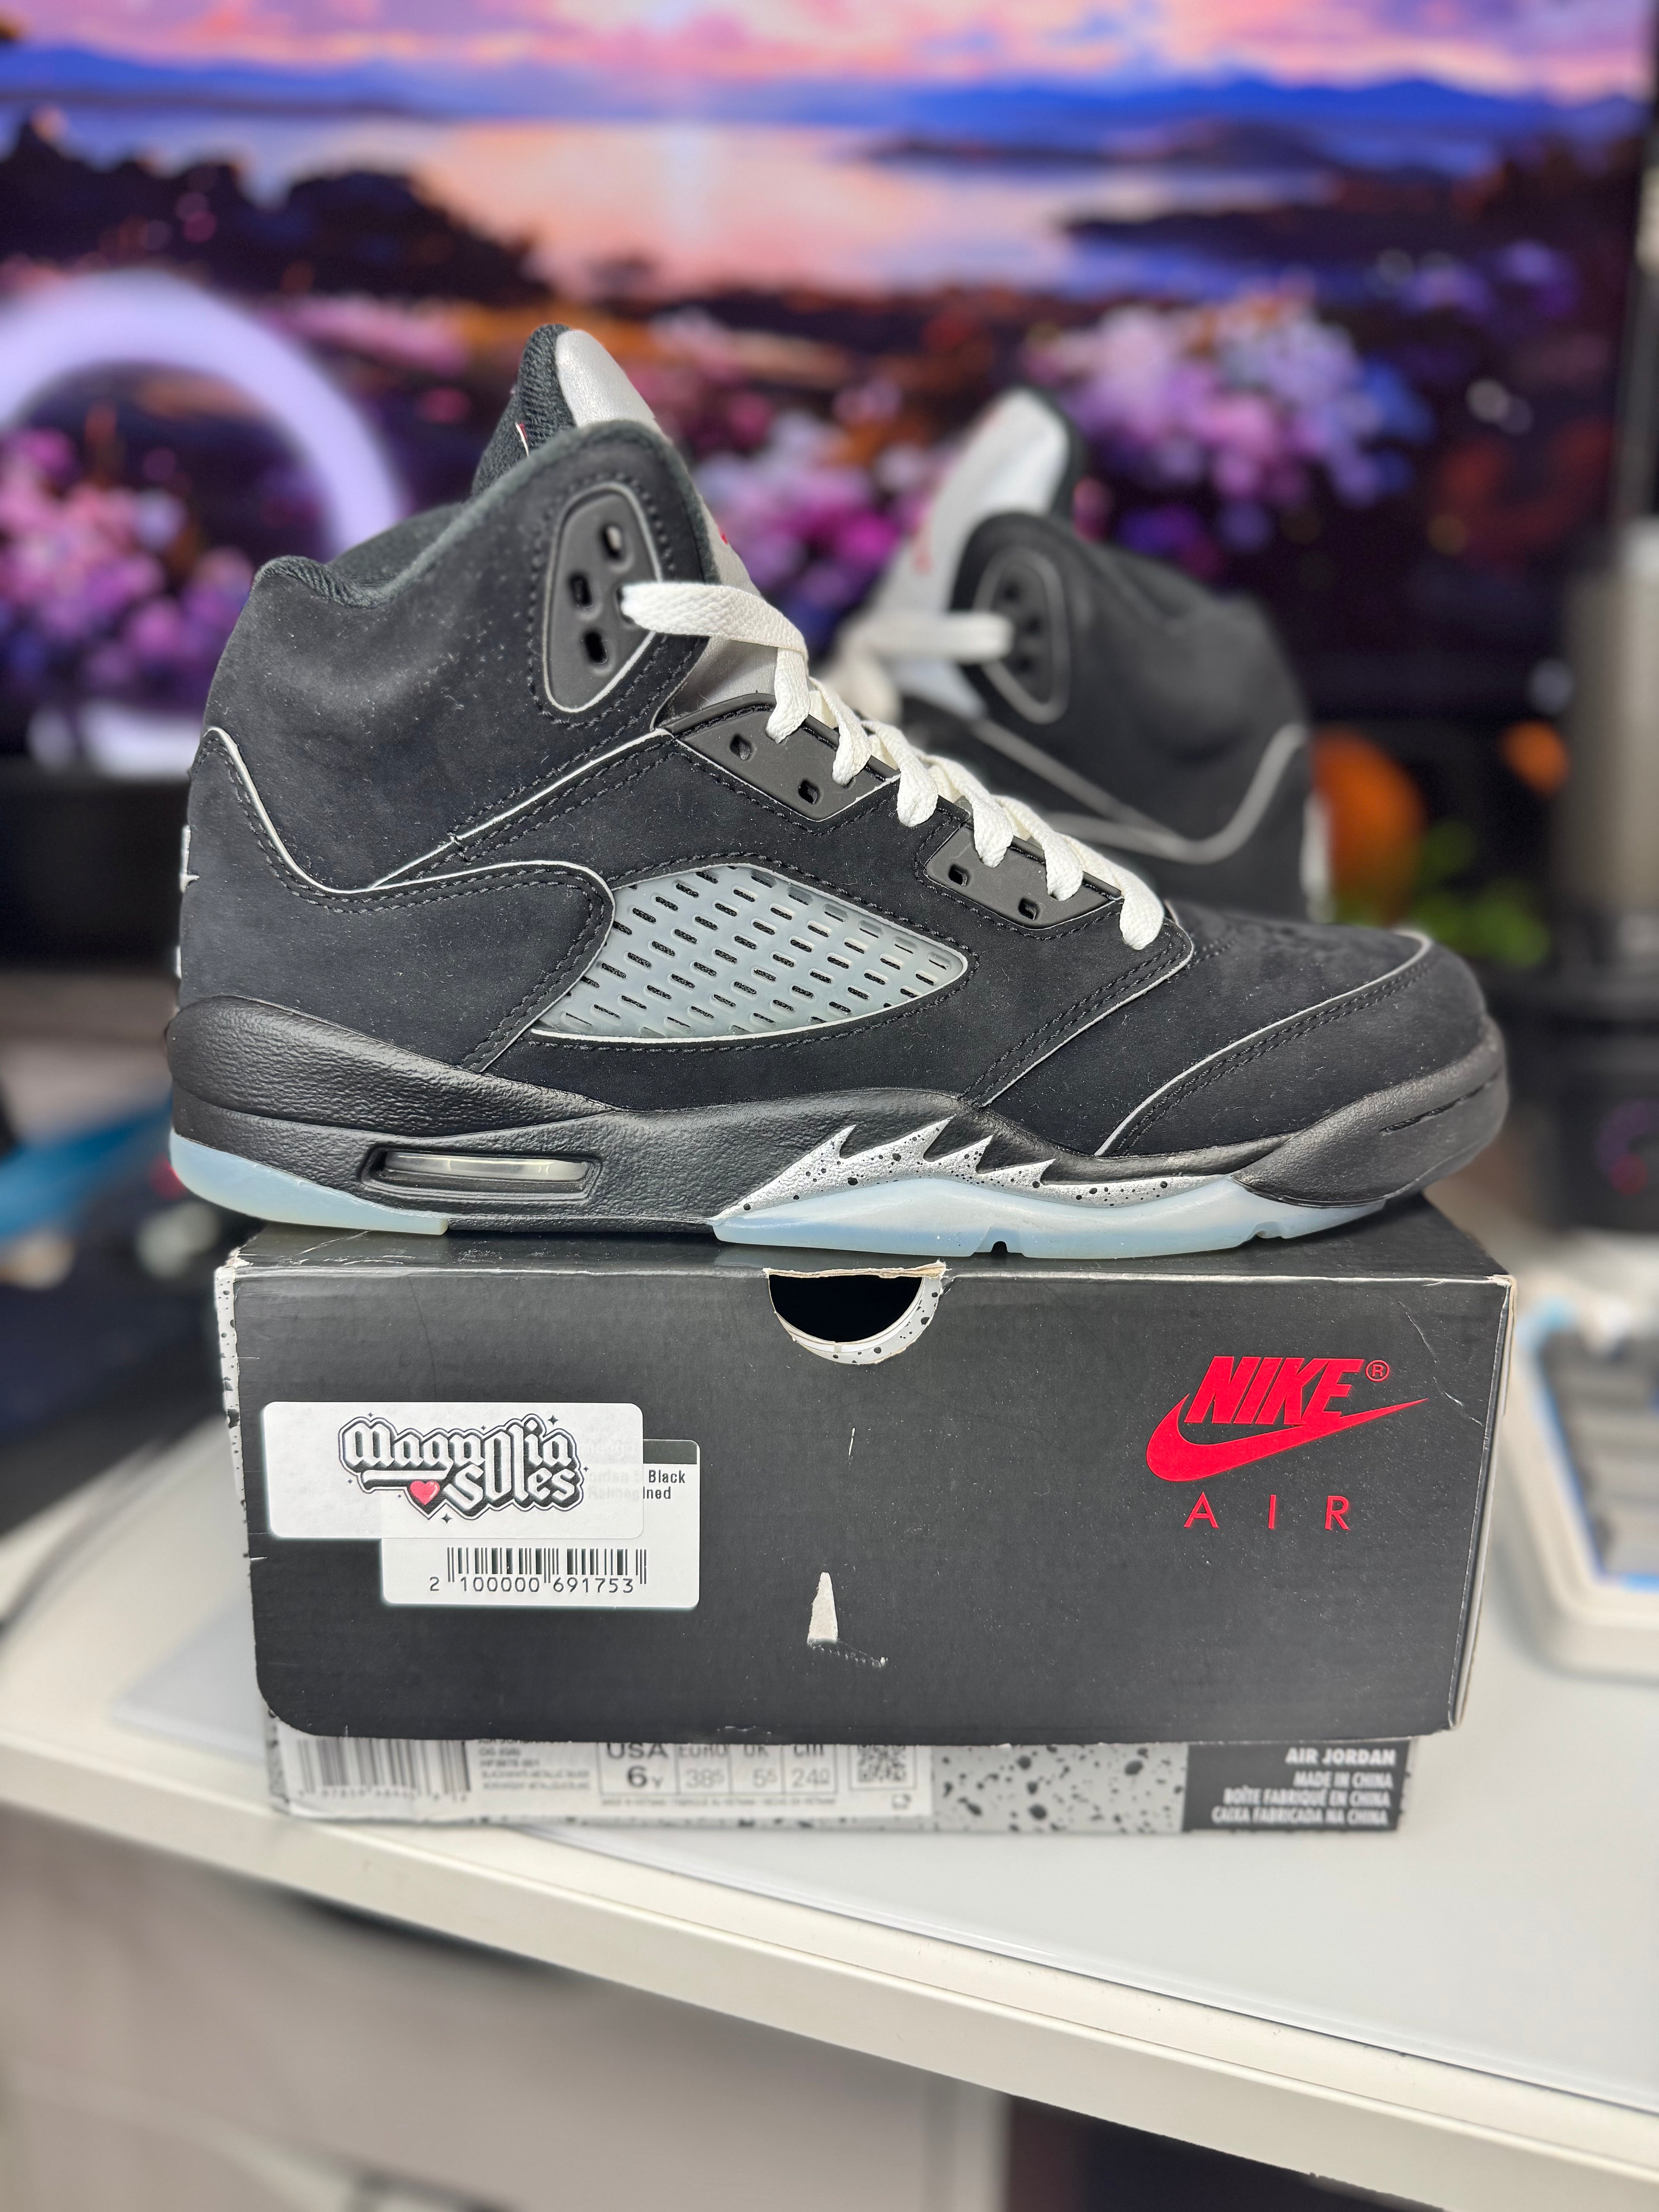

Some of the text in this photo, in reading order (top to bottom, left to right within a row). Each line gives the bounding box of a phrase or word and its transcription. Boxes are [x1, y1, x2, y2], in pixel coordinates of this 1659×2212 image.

[344, 1419, 575, 1482] Magnolia
[648, 1469, 686, 1483] Black
[1184, 1491, 1350, 1530] AIR
[430, 1577, 634, 1593] 2 100000 691753
[1285, 1748, 1396, 1765] AIR JORDAN
[1293, 1771, 1393, 1789] MADE IN CHINA
